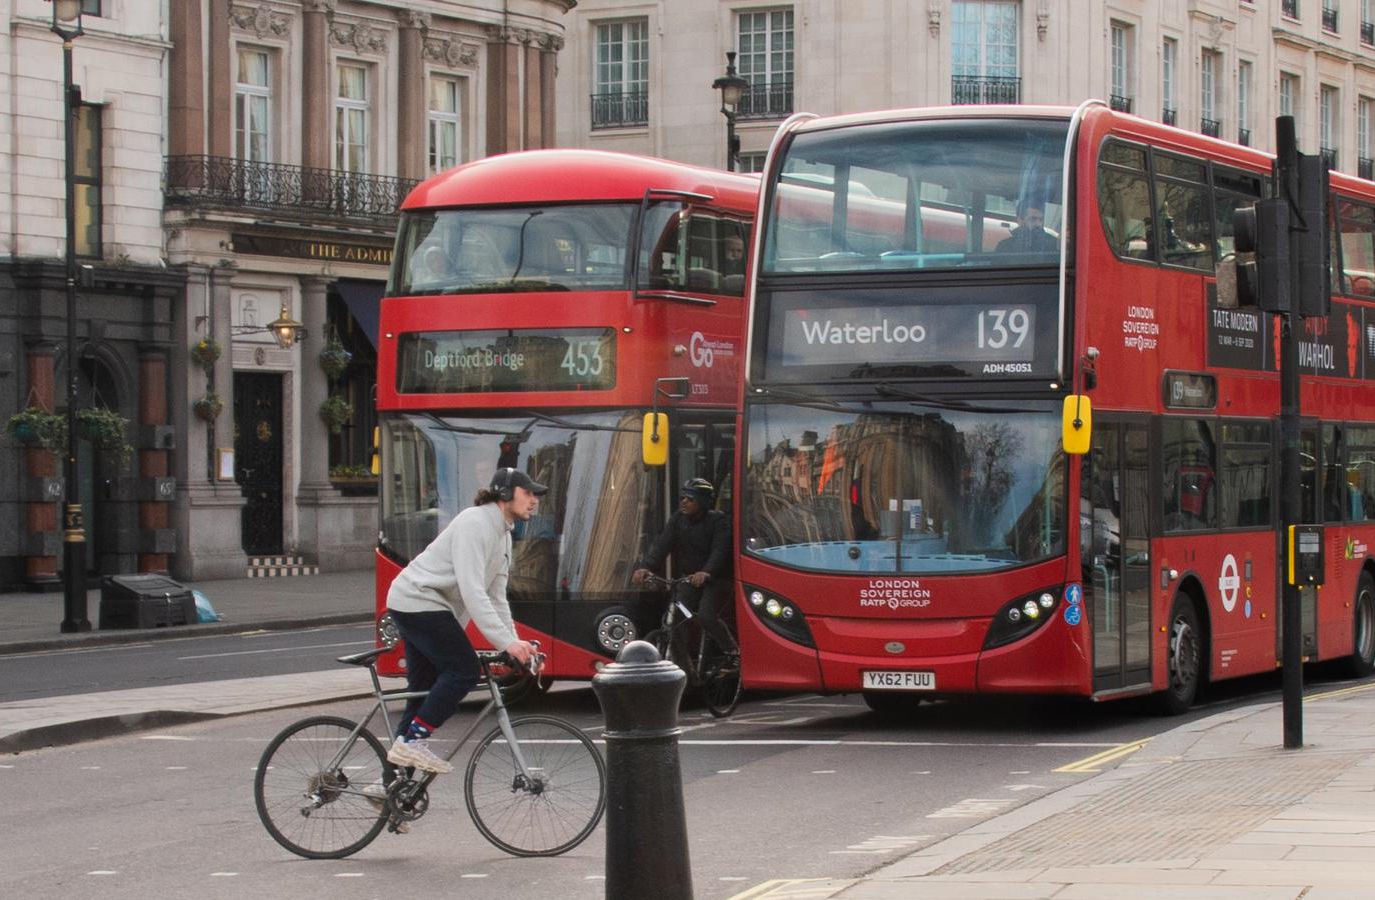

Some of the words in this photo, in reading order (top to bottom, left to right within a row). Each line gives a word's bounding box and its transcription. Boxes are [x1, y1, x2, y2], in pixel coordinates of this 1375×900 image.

[310, 243, 341, 258] THE
[1128, 306, 1154, 319] LONDON
[1122, 321, 1159, 335] SOVEREIGN
[1213, 310, 1230, 328] TATE
[1230, 312, 1258, 332] MODERN
[802, 319, 926, 345] Waterloo
[978, 309, 1030, 349] 139
[690, 331, 713, 368] Go
[1299, 341, 1335, 369] WARHOL
[425, 349, 481, 372] Deptford
[485, 349, 525, 371] Bridge
[561, 340, 603, 376] 453
[869, 580, 919, 588] LONDON
[860, 589, 930, 598] SOVEREIGN
[860, 599, 886, 607] RATP
[869, 673, 902, 686] YX62
[905, 673, 930, 686] FUU
